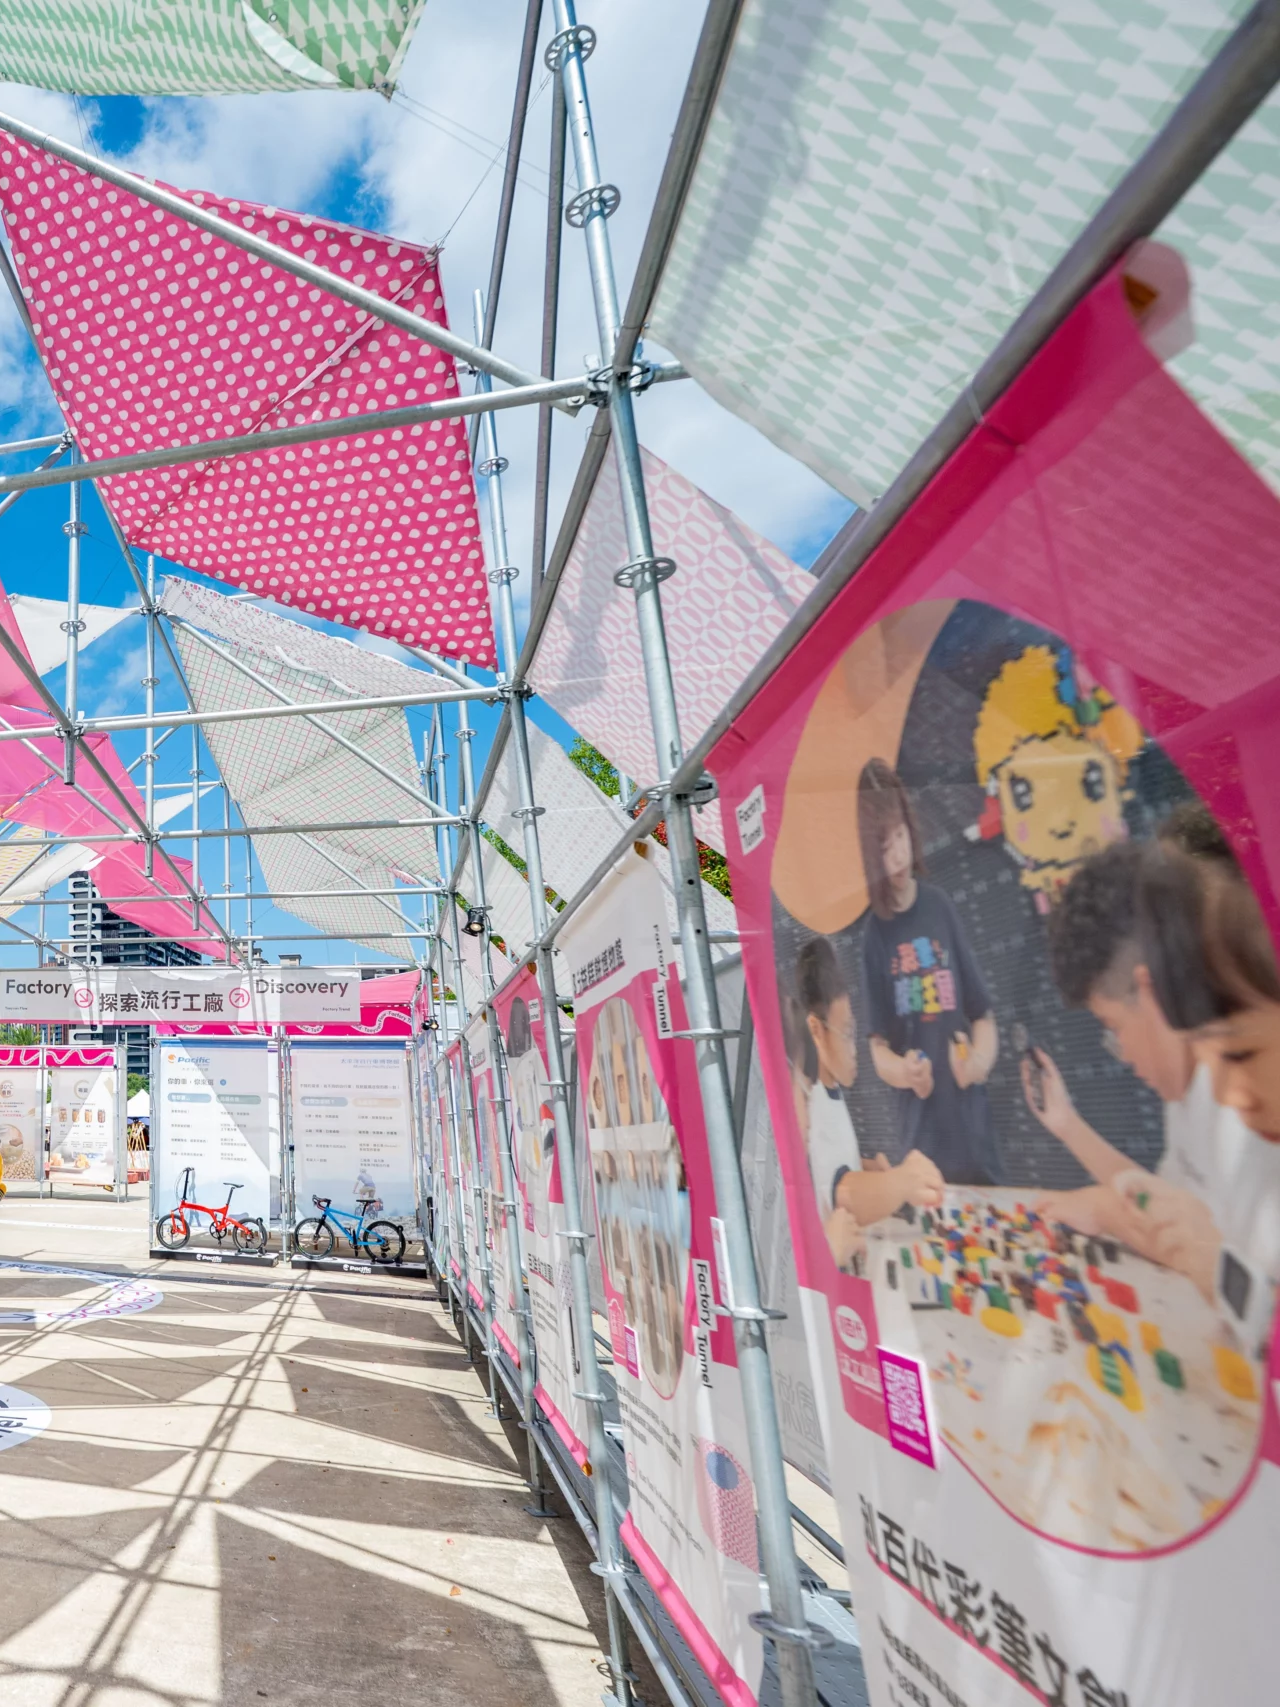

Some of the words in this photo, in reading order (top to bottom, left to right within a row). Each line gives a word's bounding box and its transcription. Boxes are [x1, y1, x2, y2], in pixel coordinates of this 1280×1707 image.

[652, 923, 667, 979] Factory
[6, 979, 72, 998] Factory
[256, 978, 349, 998] Discovery
[99, 989, 224, 1013] 探索流行工廠
[656, 985, 669, 1036] Tunnel
[696, 1261, 713, 1325] Factory
[698, 1331, 713, 1389] Tunnel
